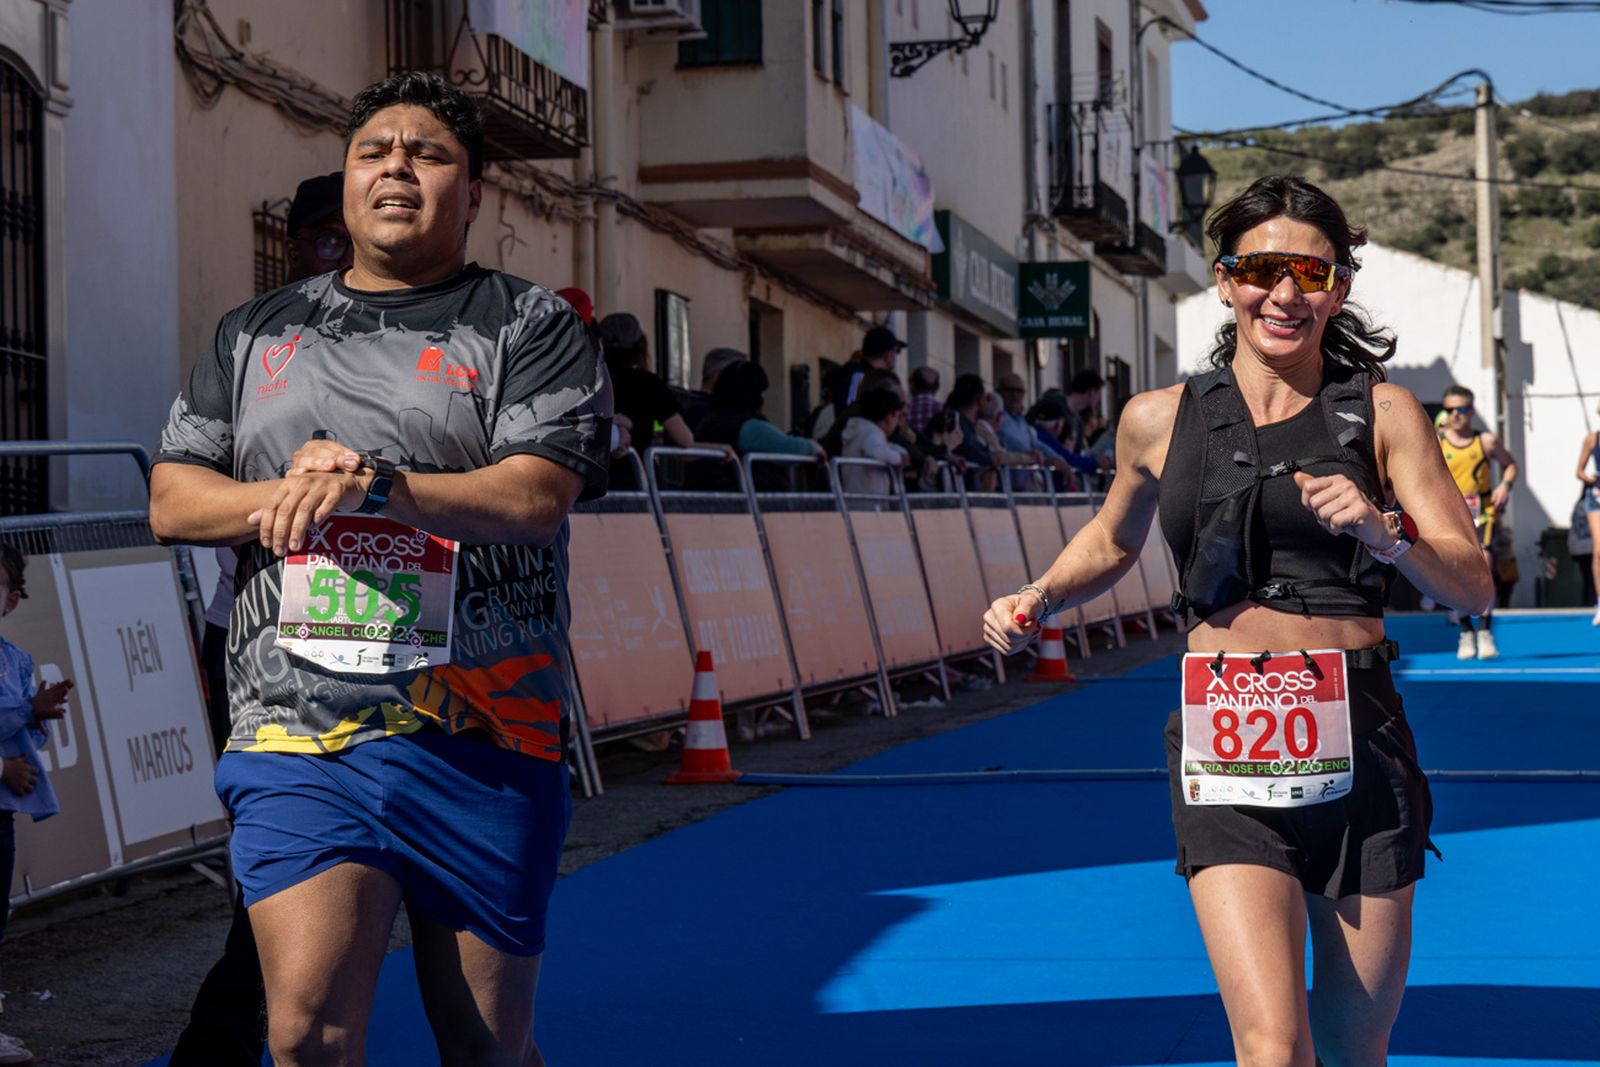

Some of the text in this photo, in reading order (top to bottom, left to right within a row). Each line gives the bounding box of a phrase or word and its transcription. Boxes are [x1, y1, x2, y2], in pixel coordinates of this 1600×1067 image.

[308, 521, 334, 551] X
[337, 531, 426, 557] CROSS
[306, 553, 424, 574] PANTANO DEL
[307, 569, 422, 627] 505
[280, 624, 304, 637] JOS
[312, 625, 348, 638] ANGEL
[117, 619, 164, 692] JAÉN
[1206, 663, 1231, 692] X
[1232, 671, 1318, 694] CROSS
[1206, 692, 1318, 711] PANTANO DEL
[1212, 707, 1319, 761] 820
[127, 727, 194, 785] MARTOS
[1185, 761, 1223, 774] MARIA
[1226, 763, 1254, 775] JOSE
[1297, 759, 1350, 774] MRENO
